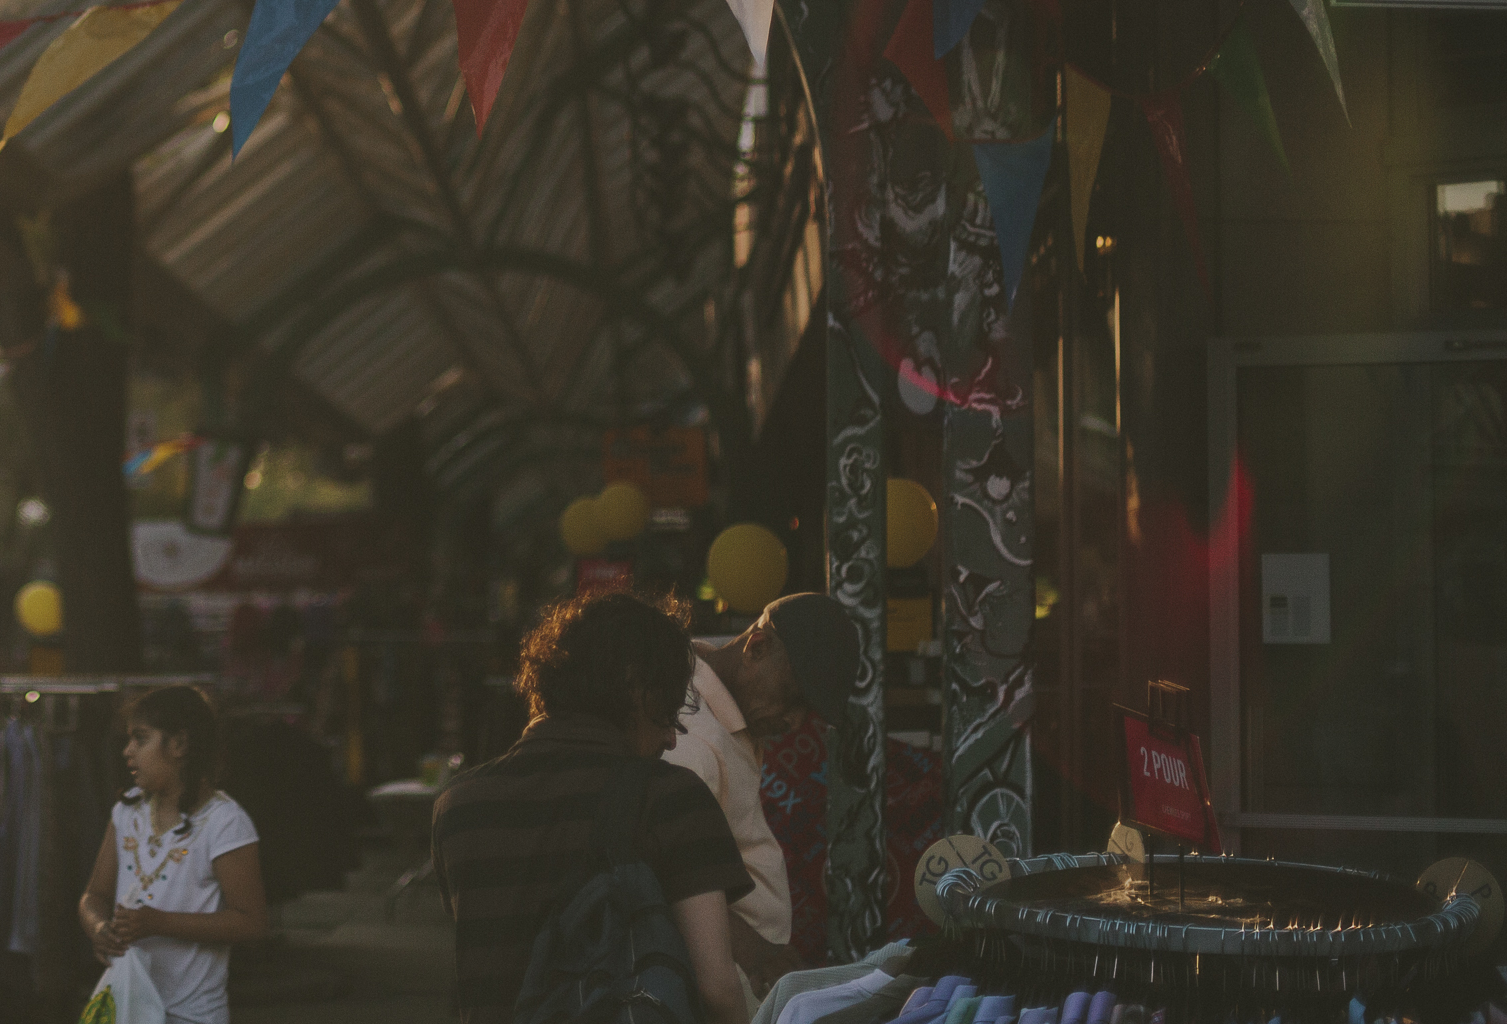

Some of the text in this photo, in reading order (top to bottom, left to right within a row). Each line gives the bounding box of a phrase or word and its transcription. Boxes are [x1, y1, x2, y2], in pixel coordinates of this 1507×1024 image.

[1140, 746, 1190, 791] 2 POUR
[919, 855, 949, 886] TG
[971, 844, 1004, 882] TG
